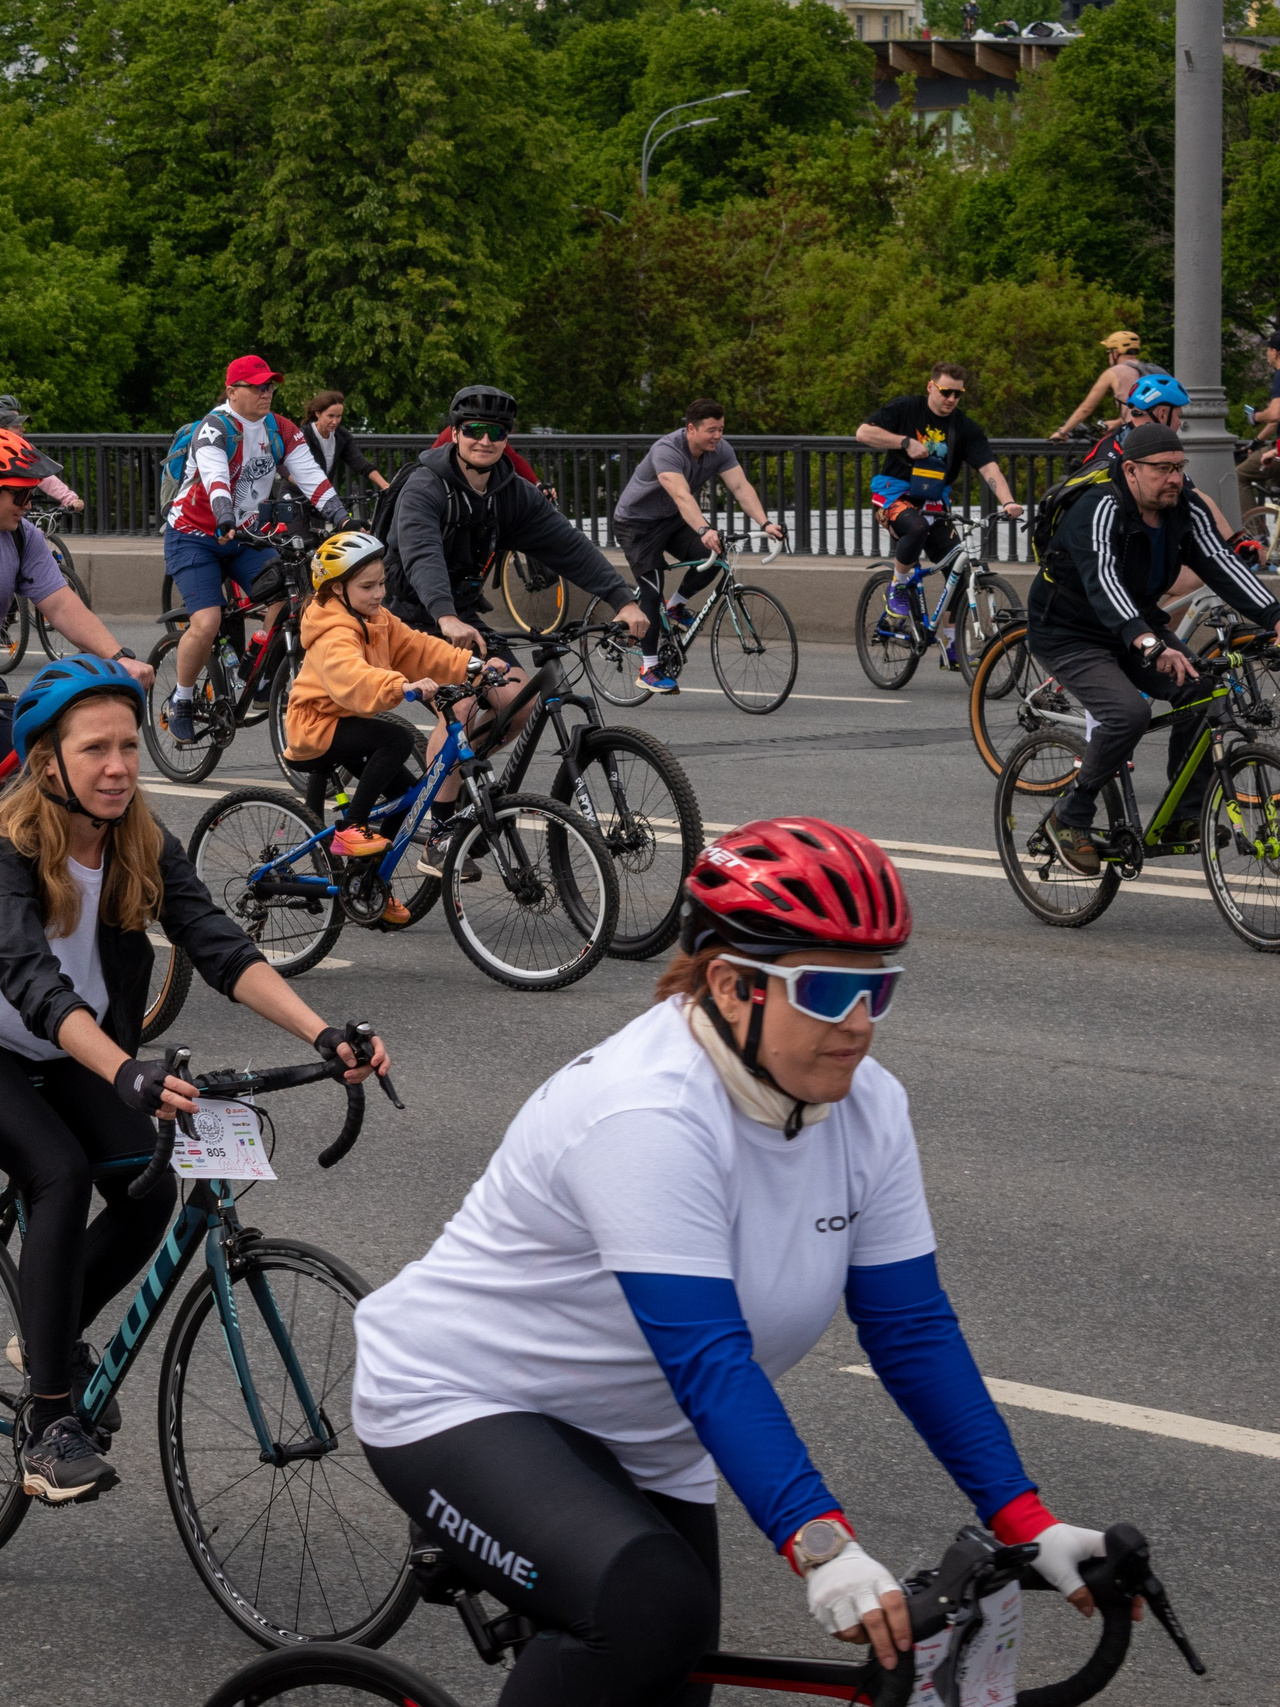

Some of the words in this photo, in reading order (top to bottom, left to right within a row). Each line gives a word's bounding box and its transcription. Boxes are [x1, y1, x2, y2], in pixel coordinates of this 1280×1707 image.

[682, 590, 717, 646] Bianchi
[499, 698, 544, 787] SPECIALIZED
[578, 794, 597, 827] FOX
[700, 845, 751, 869] MET
[1173, 846, 1186, 854] X9
[206, 1147, 226, 1157] 805
[84, 1216, 182, 1421] SCOTT
[223, 1271, 240, 1332] SCOTT
